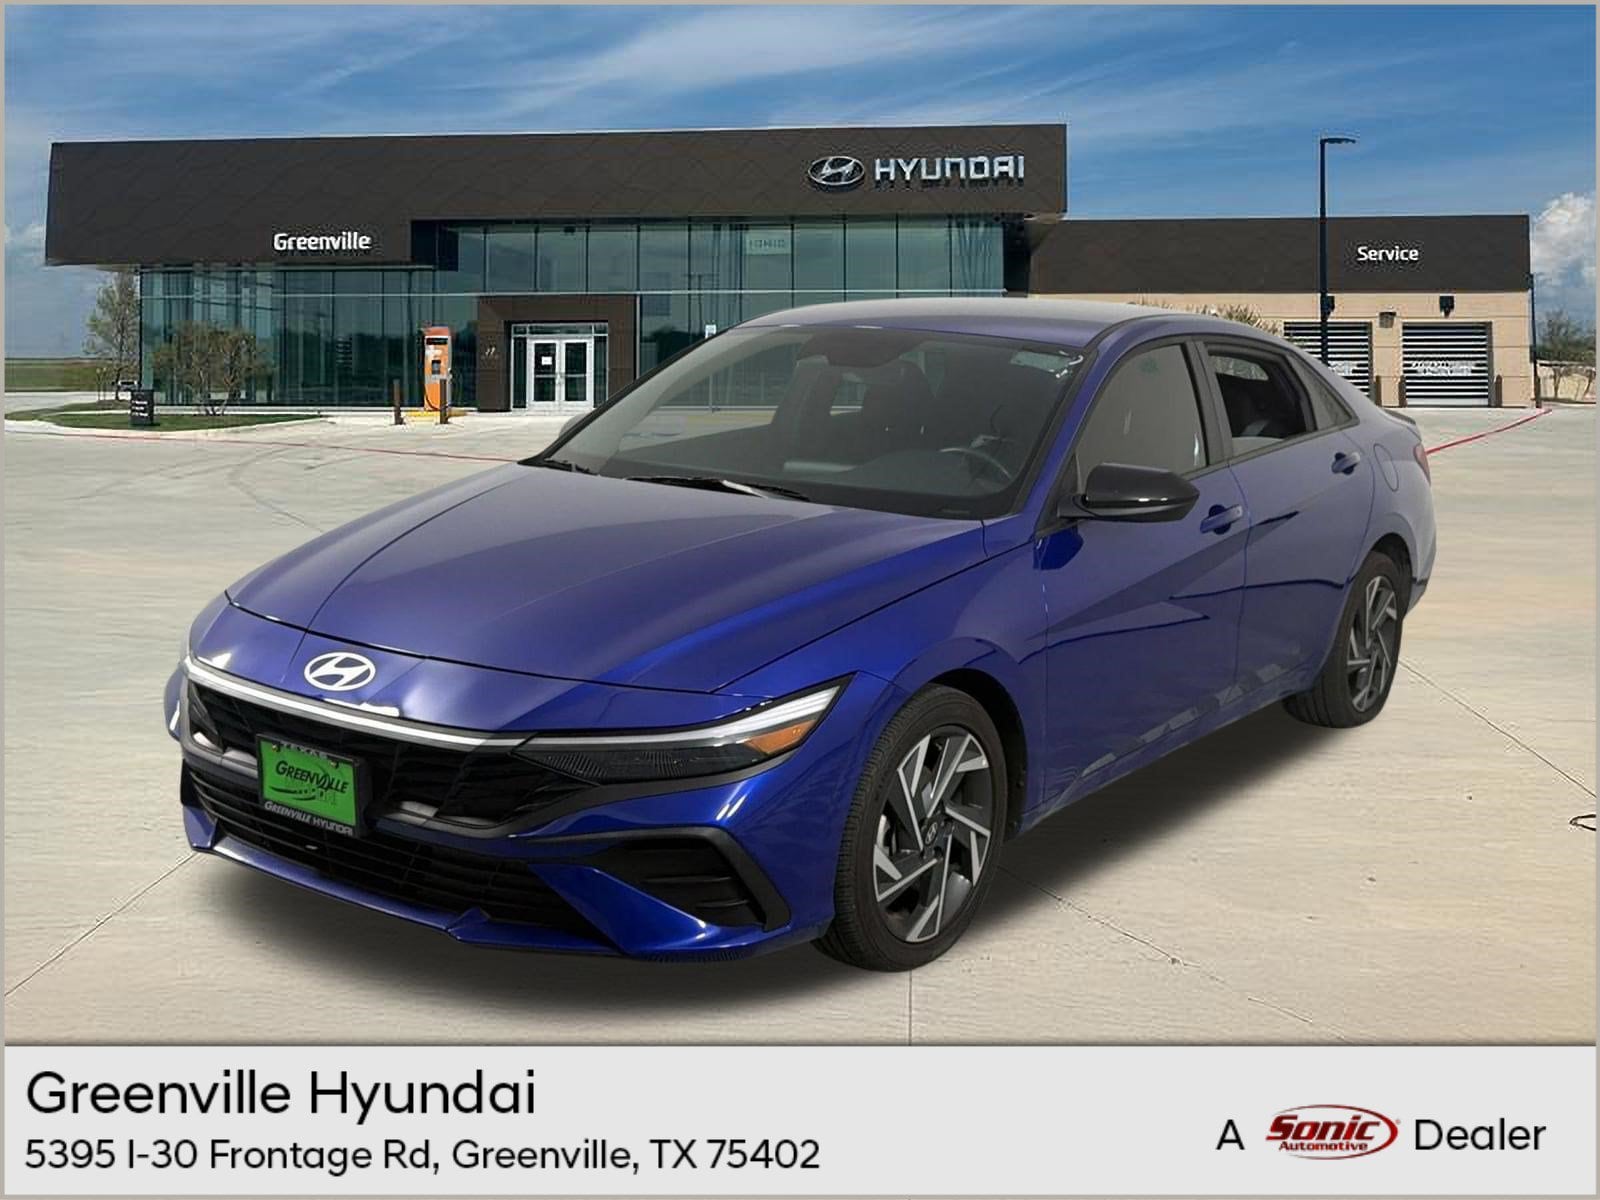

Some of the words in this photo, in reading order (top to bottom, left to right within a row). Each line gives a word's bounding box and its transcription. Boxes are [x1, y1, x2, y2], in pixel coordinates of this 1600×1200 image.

[874, 155, 1025, 181] HYUNDAI
[273, 231, 372, 251] Greenville
[1357, 245, 1419, 261] Service
[275, 760, 349, 793] GREENVILLE
[264, 800, 311, 824] GREENVILLE
